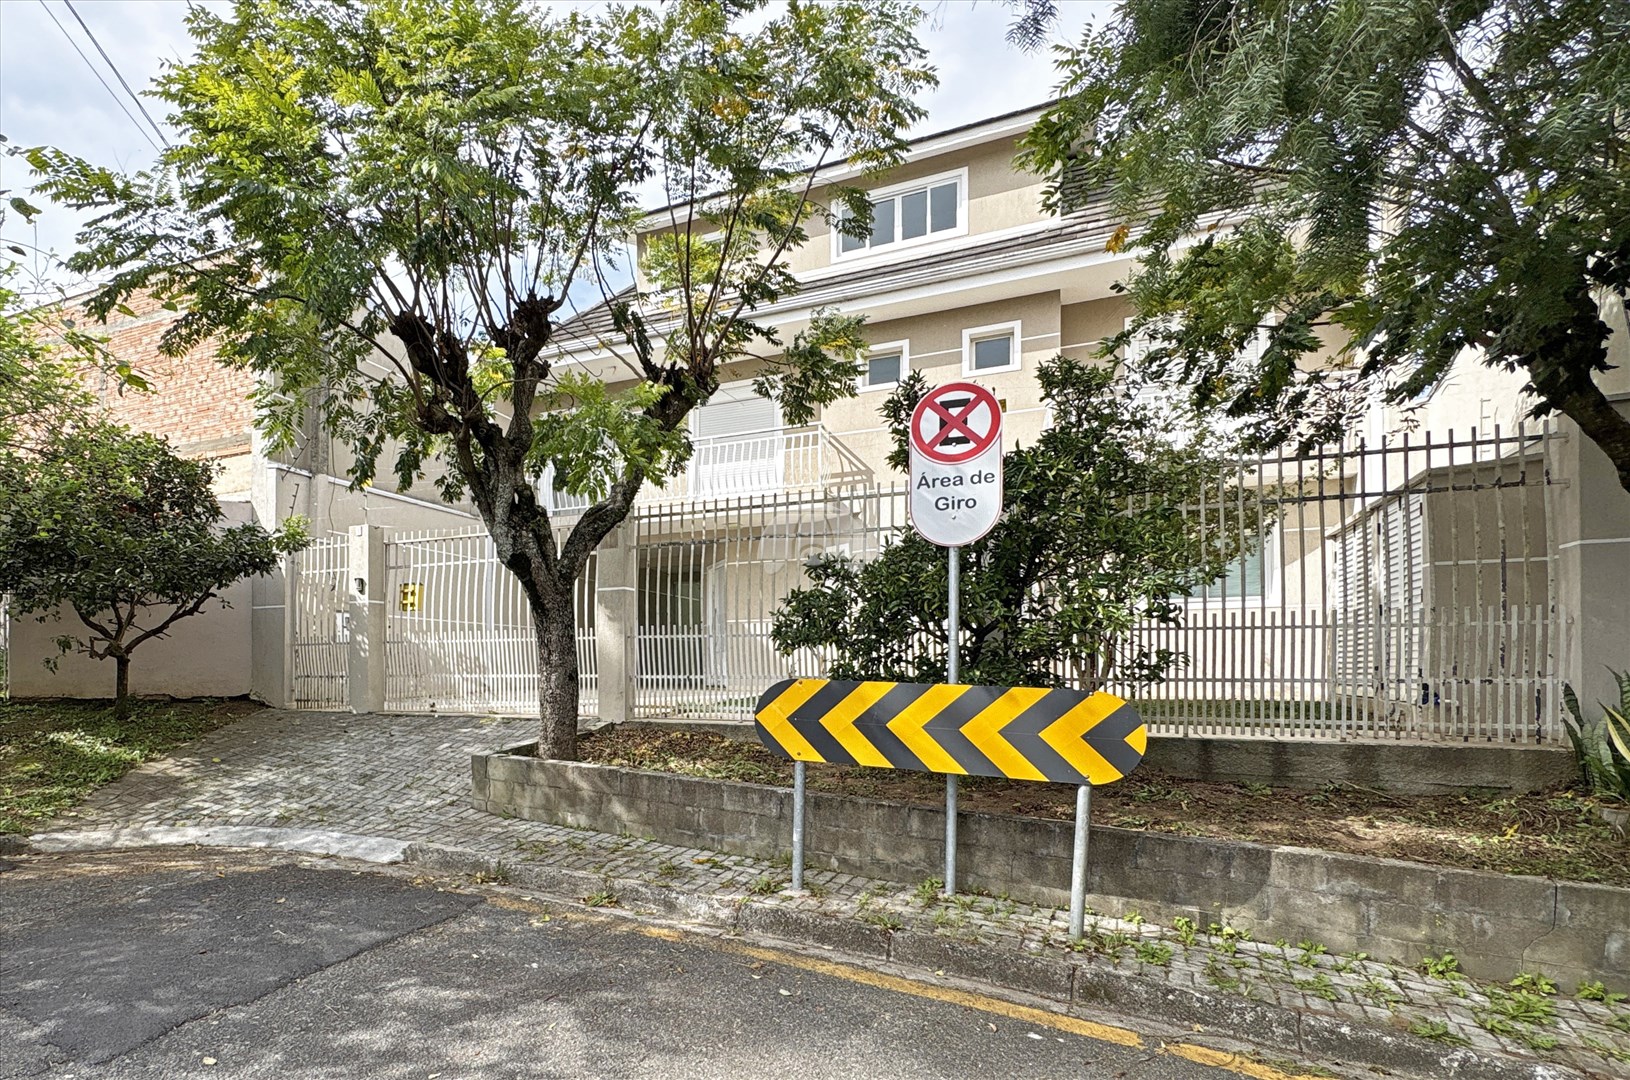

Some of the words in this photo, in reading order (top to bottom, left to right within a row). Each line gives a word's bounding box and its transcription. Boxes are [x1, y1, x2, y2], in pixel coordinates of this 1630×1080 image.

[917, 472, 963, 490] Área
[970, 470, 995, 485] de
[934, 496, 977, 511] Giro
